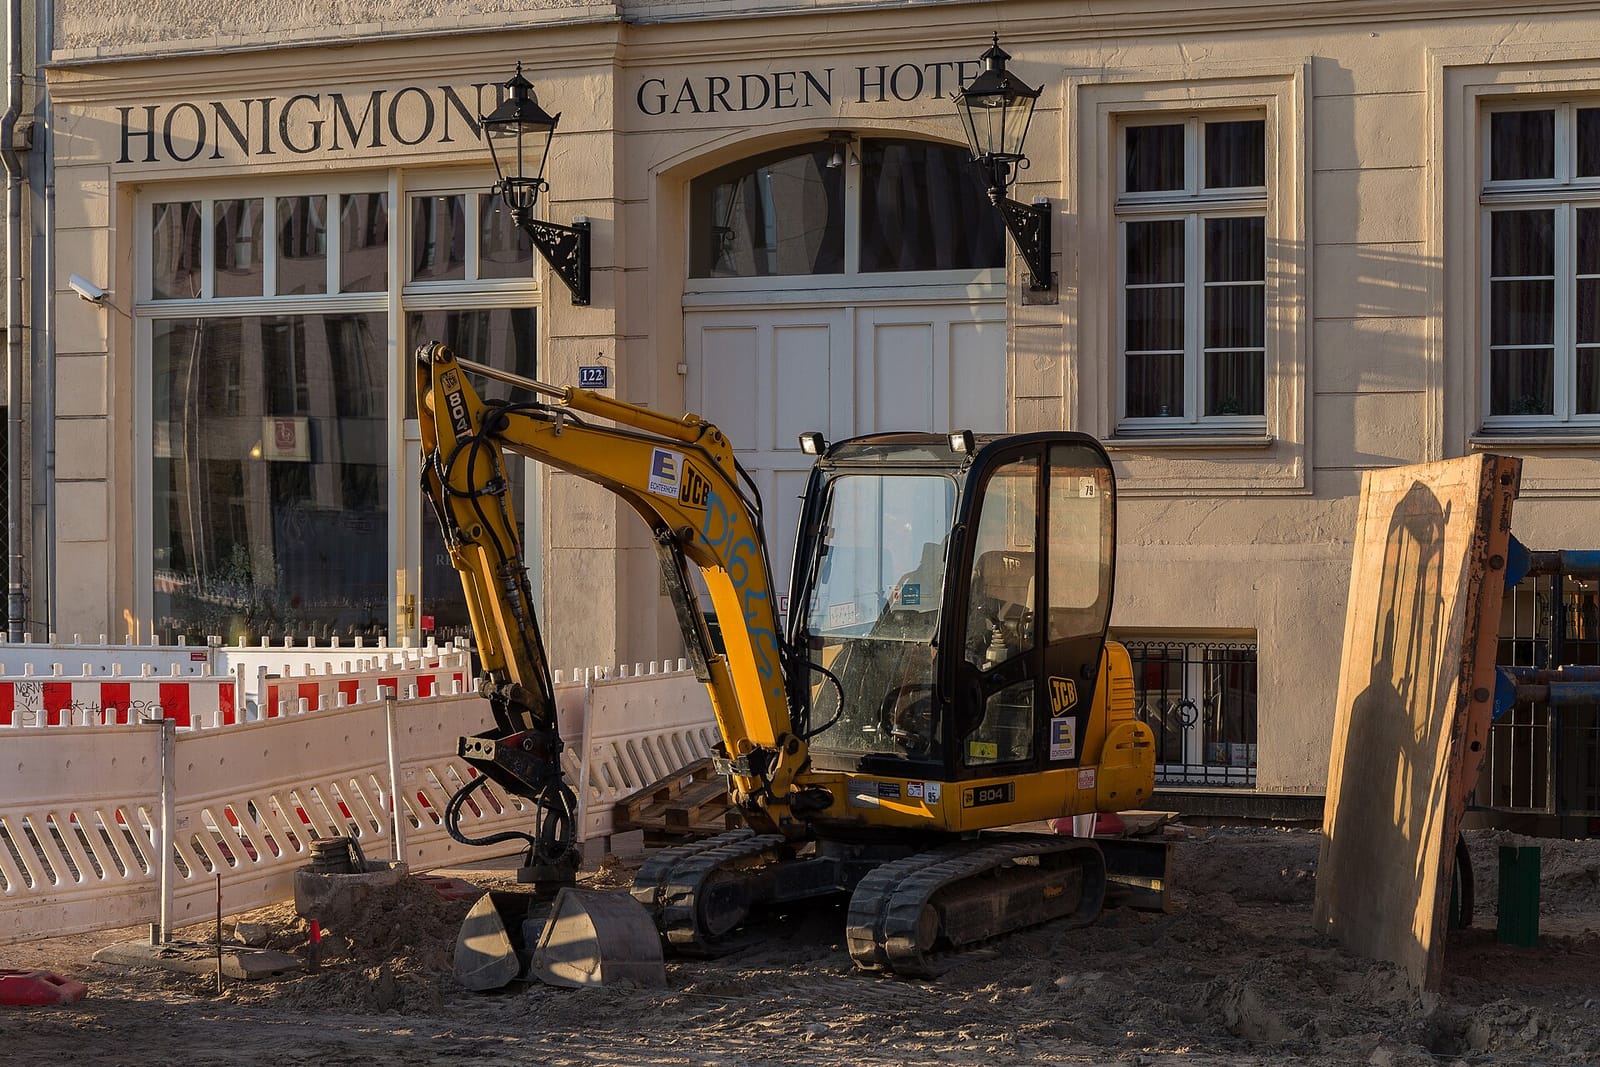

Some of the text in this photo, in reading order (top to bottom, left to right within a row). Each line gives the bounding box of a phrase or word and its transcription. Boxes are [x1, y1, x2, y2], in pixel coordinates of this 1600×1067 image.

[636, 60, 983, 116] GARDEN HOTE
[582, 369, 604, 381] 122
[449, 392, 468, 431] 804
[682, 467, 710, 506] JCB
[1085, 485, 1093, 496] 79
[1053, 681, 1075, 712] JCB
[979, 787, 1003, 802] 804
